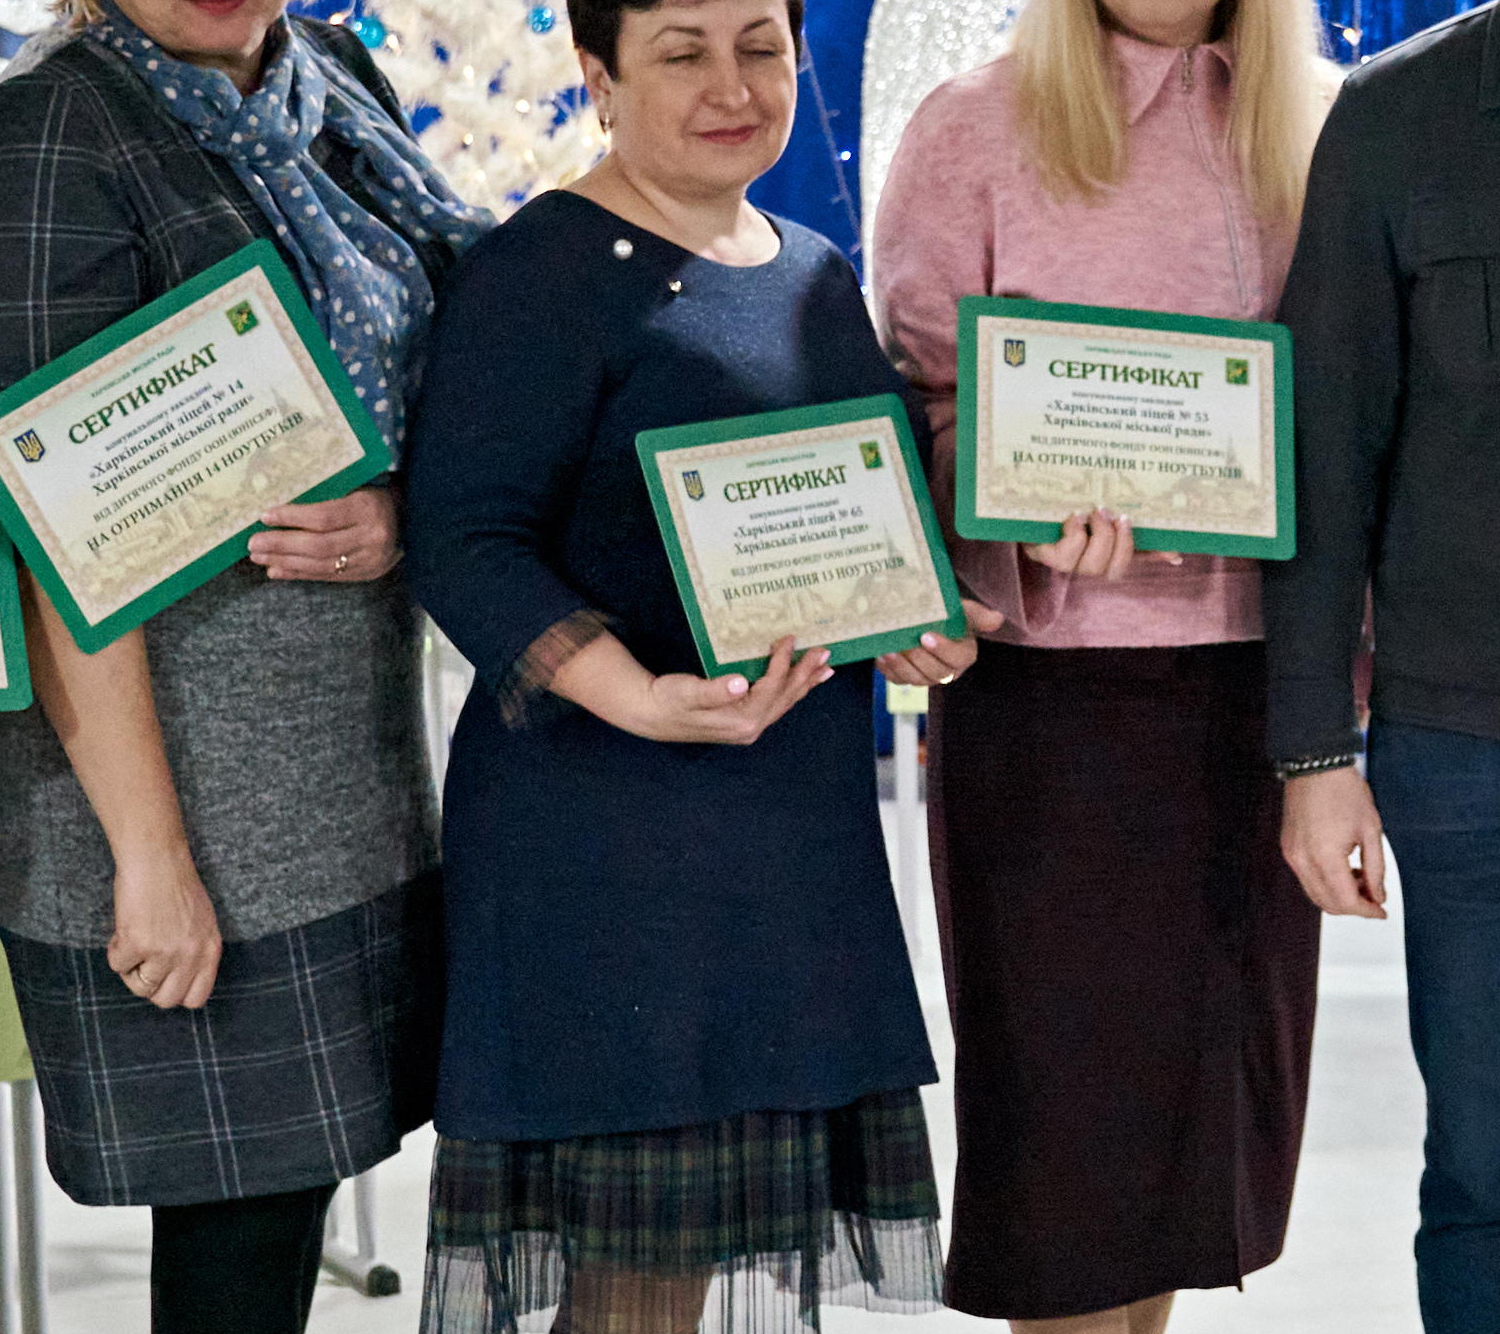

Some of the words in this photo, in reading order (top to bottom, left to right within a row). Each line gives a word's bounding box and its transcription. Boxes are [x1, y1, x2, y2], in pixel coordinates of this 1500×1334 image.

[67, 342, 219, 445] СЕРТИФІКАТ
[1049, 359, 1203, 389] СЕРТИФІКАТ
[88, 421, 176, 480] «Харківський
[176, 399, 212, 427] ліцей
[91, 442, 170, 497] Харківської
[169, 413, 217, 449] міської
[217, 394, 255, 424] ради»
[1037, 453, 1136, 470] ОТРИМАННЯ
[86, 531, 110, 552] НА
[109, 471, 204, 536] ОТРИМАННЯ
[205, 461, 221, 478] 14
[220, 411, 303, 468] НОУТБУКІВ
[723, 464, 848, 503] СЕРТИФІКАТ
